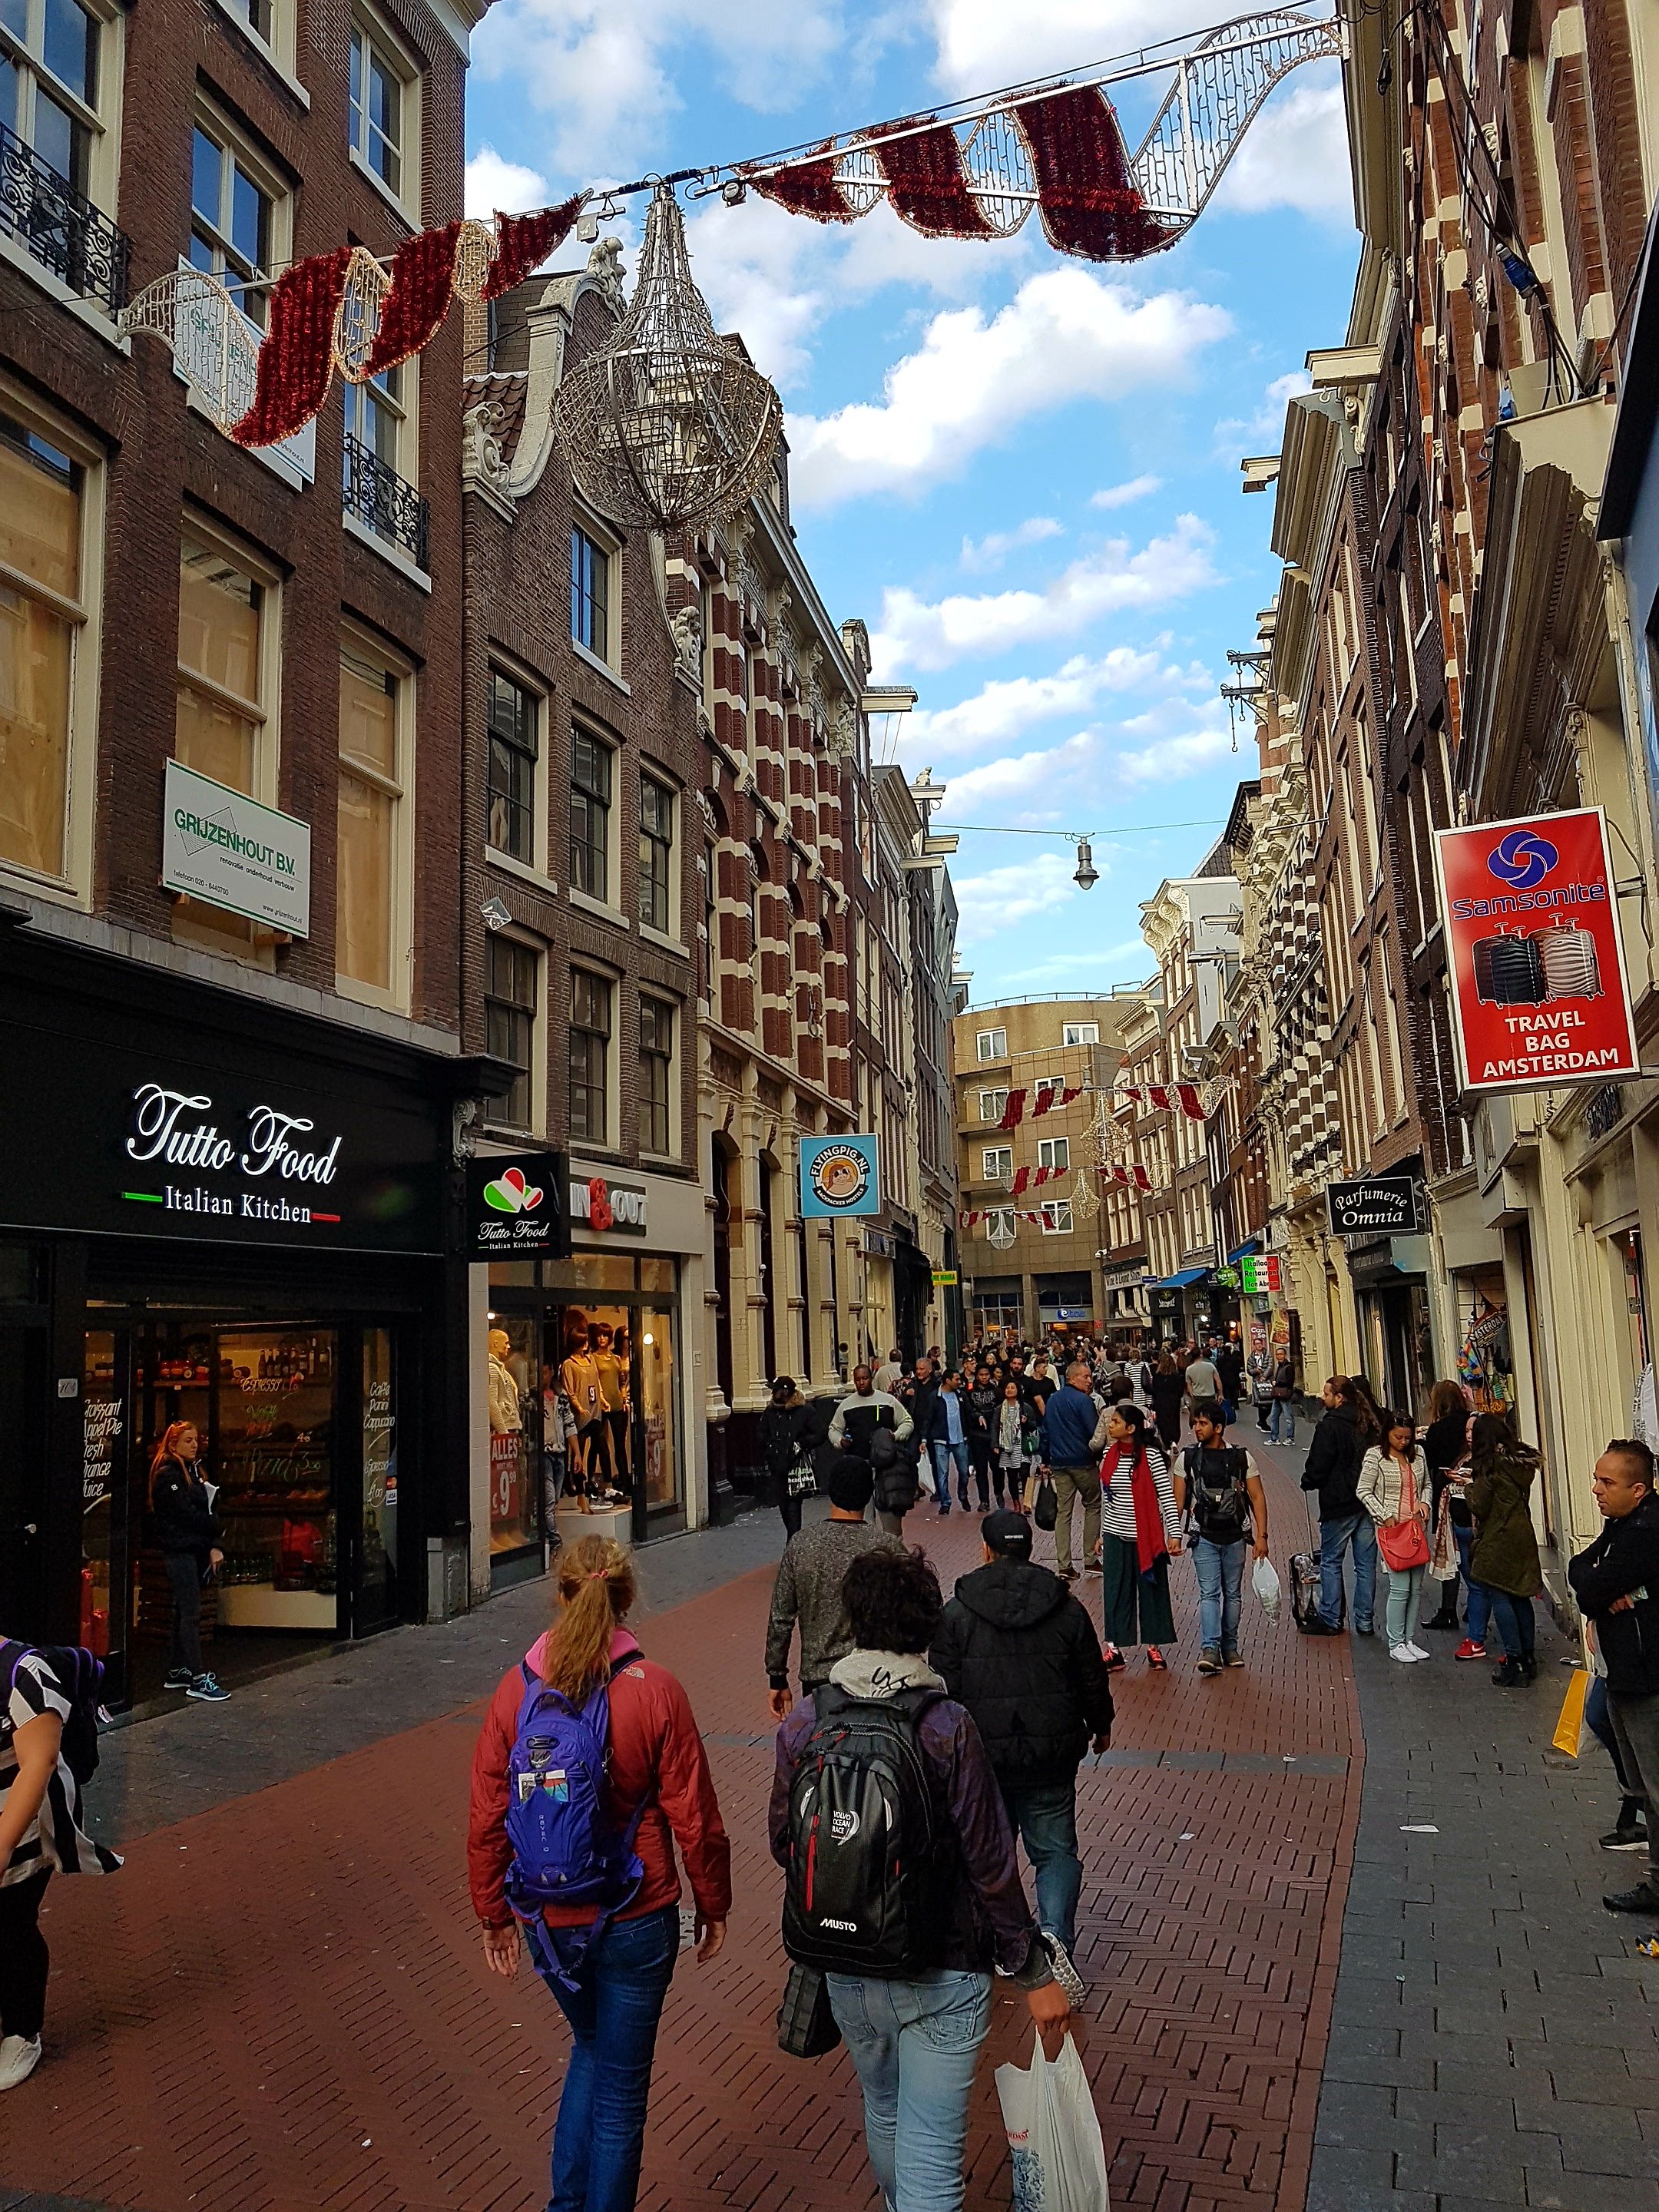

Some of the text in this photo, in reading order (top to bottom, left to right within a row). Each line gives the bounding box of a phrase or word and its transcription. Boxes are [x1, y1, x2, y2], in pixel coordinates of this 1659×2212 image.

[174, 809, 296, 876] GRIJZENHOUT B.V.
[174, 869, 194, 883] telefoon
[220, 856, 295, 892] renovatie onderhoud verbouw
[1452, 883, 1606, 920] Samsonite
[1505, 1010, 1585, 1034] TRAVEL
[1525, 1032, 1570, 1052] BAG
[1482, 1048, 1619, 1078] AMSTERDAM
[127, 1083, 343, 1184] Tutto Food
[811, 1146, 869, 1176] FLYINGPIG.NL
[165, 1185, 311, 1223] Italian Kitchen
[590, 1177, 614, 1230] &
[611, 1190, 647, 1226] OUT
[817, 1187, 864, 1206] BACKPACKER HOSTELS
[1335, 1186, 1408, 1210] Parfumerie
[1343, 1207, 1404, 1226] Omnia
[478, 1220, 550, 1240] Tutto Food
[492, 1438, 518, 1461] ALLES
[833, 1810, 851, 1820] VOLVO
[833, 1818, 850, 1828] OCEAN
[832, 1825, 845, 1834] RACE
[820, 1918, 857, 1932] MUSTO
